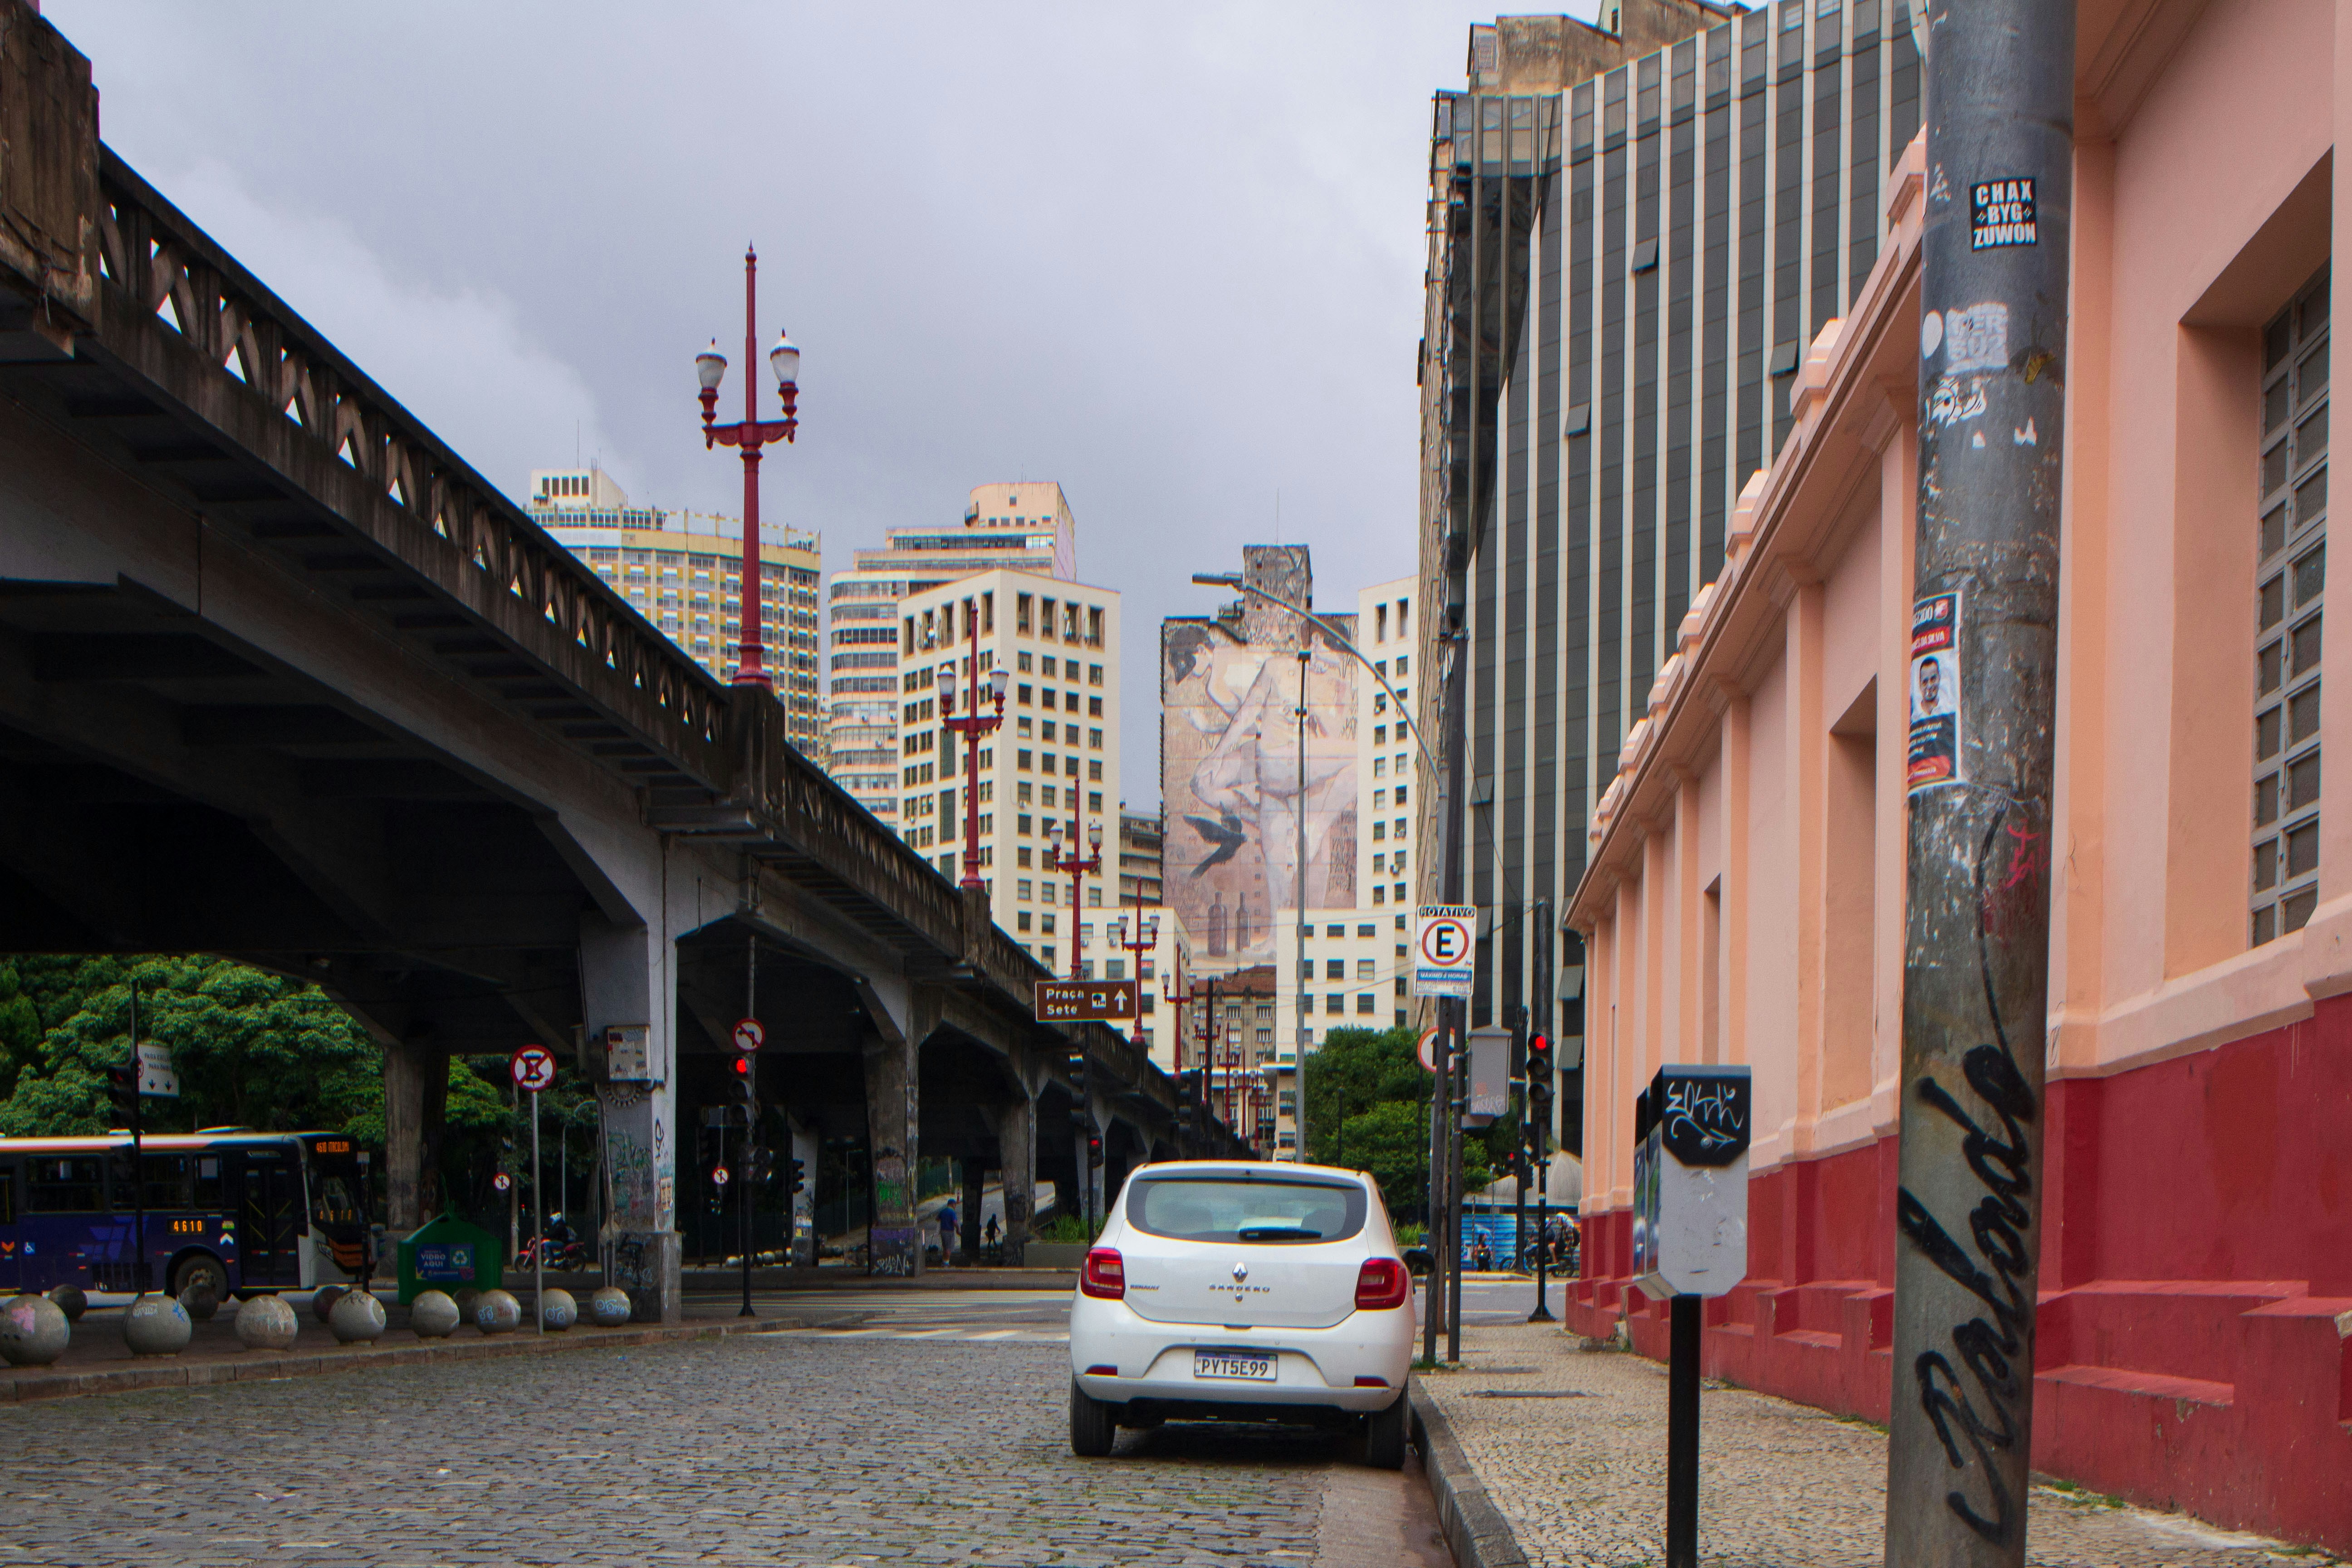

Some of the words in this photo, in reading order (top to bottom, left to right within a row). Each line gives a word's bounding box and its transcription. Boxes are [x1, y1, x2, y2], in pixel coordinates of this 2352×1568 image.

[1976, 180, 2032, 207] CHAX
[1988, 202, 2022, 225] BYG
[1974, 222, 2036, 250] ZUWON
[1927, 630, 1945, 645] SILVA
[1420, 907, 1474, 916] ROTATIVO
[1436, 926, 1455, 958] E
[1046, 988, 1084, 1000] Praça
[1047, 1004, 1078, 1016] Sete
[174, 1220, 202, 1232] 4610
[1209, 1283, 1270, 1292] SANDERO
[1202, 1358, 1268, 1377] PYT5E99
